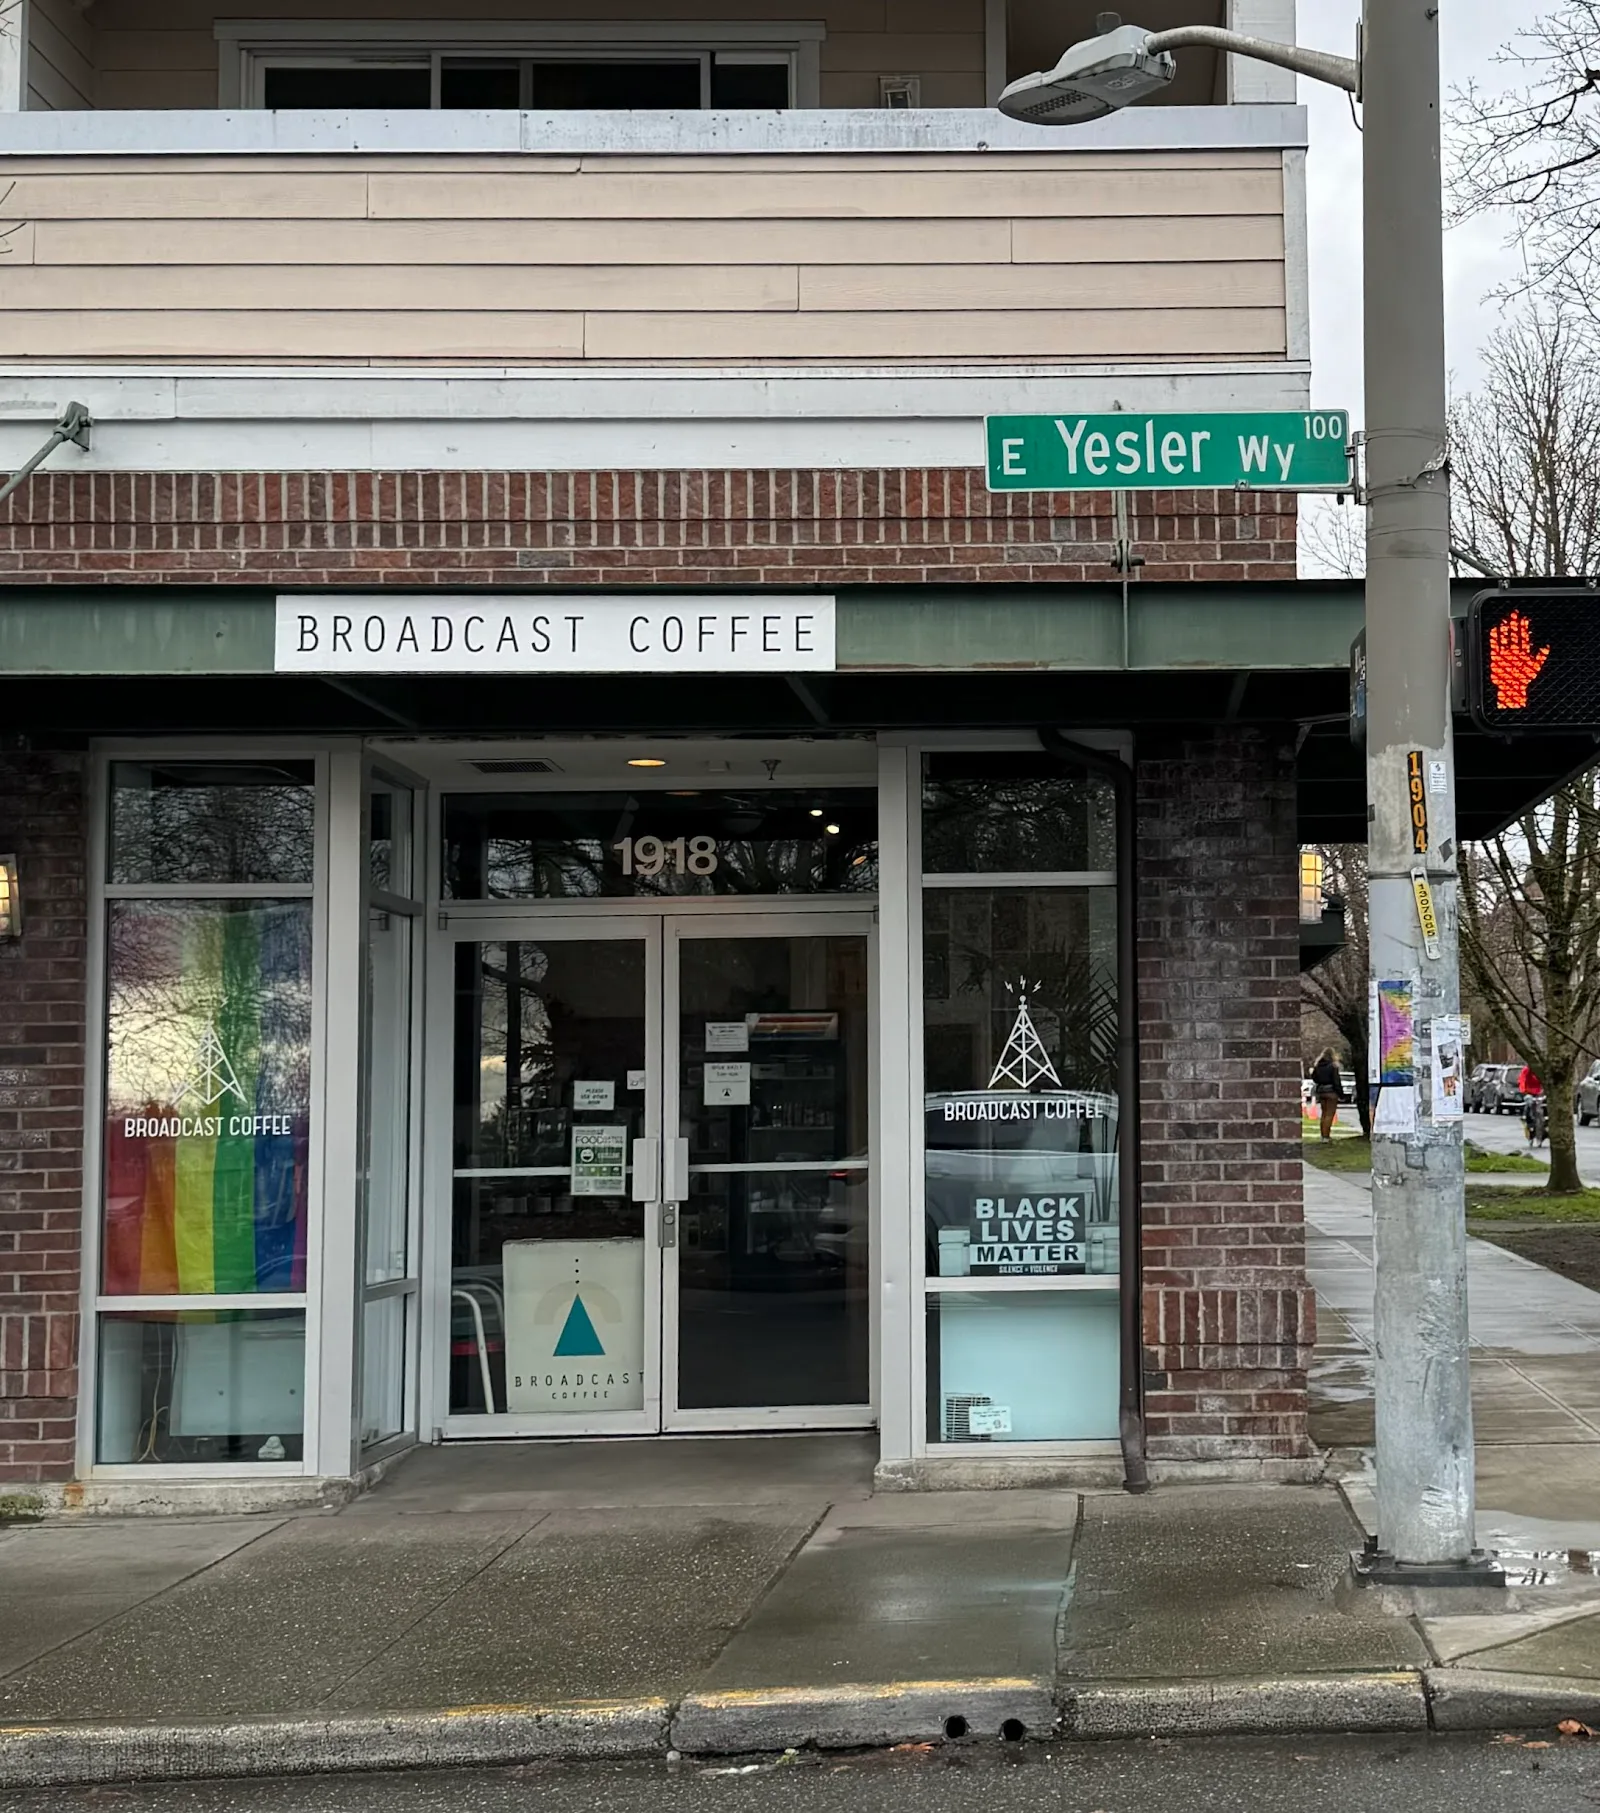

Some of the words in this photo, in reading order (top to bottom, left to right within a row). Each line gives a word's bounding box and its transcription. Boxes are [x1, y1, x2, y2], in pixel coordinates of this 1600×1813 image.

[1304, 415, 1343, 440] 100
[1002, 437, 1027, 476] E
[1054, 419, 1211, 475] Yesler
[1237, 435, 1295, 482] Wy
[296, 615, 585, 653] BROADCAST
[629, 615, 814, 653] COFFEE
[1409, 752, 1428, 854] 1904
[613, 835, 718, 876] 1918
[944, 1100, 1040, 1121] BROADCAST
[1045, 1099, 1104, 1119] COFFEE
[124, 1116, 225, 1138] BROADCAST
[229, 1115, 291, 1136] COFFEE
[975, 1197, 1080, 1219] BLACK
[981, 1219, 1075, 1242] LIVES
[977, 1244, 1079, 1263] MATTER
[999, 1265, 1024, 1274] SILENCE
[1029, 1264, 1058, 1273] VIOLENCE
[514, 1371, 644, 1388] BROADCAST
[551, 1390, 609, 1400] COFFEE
